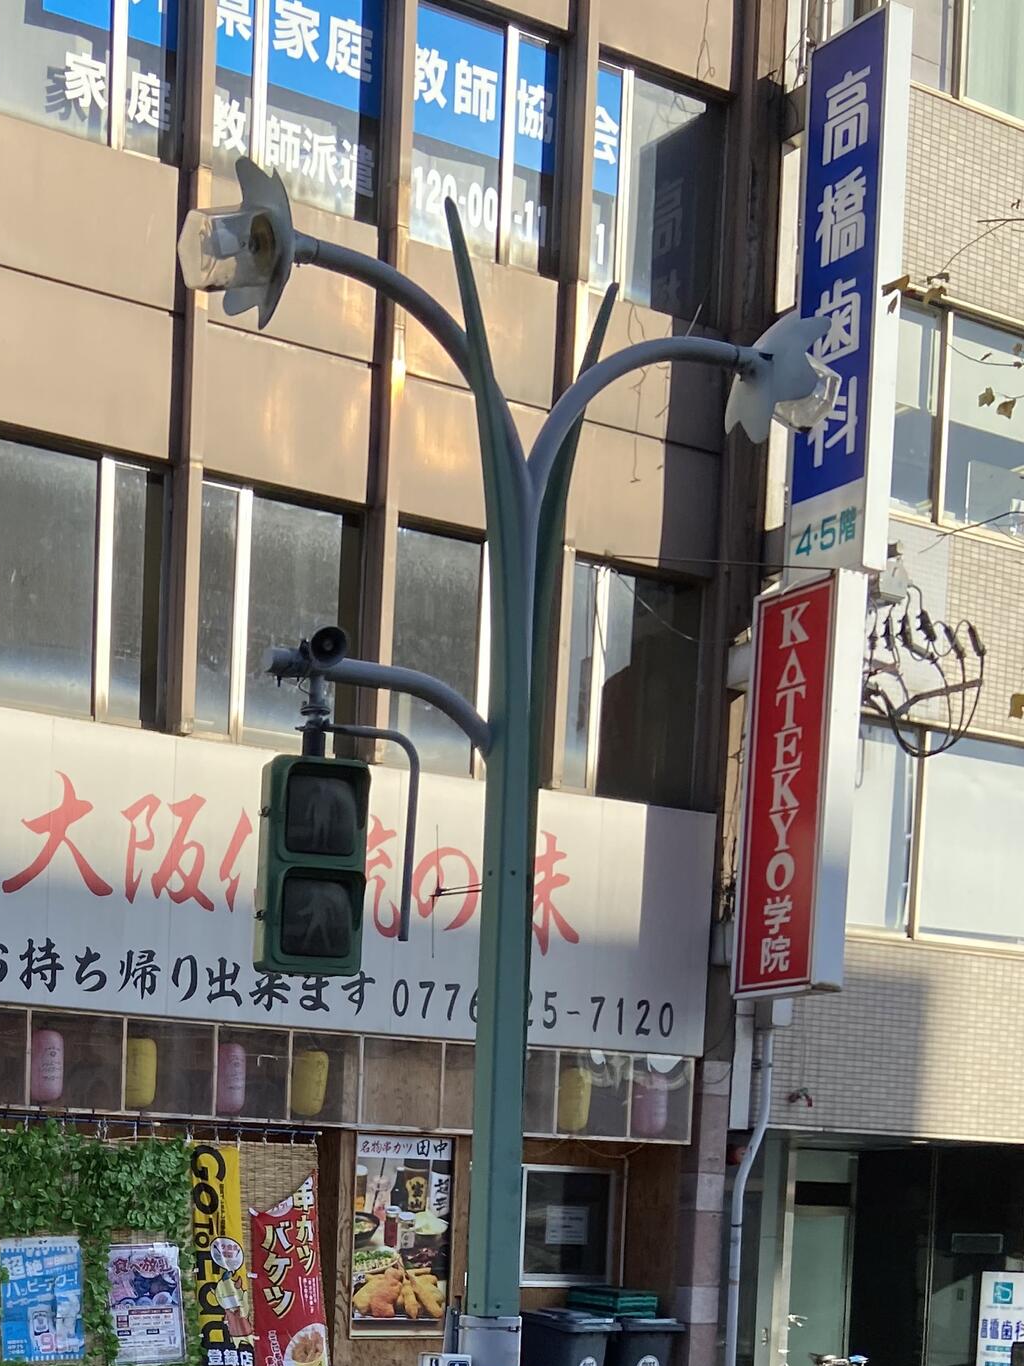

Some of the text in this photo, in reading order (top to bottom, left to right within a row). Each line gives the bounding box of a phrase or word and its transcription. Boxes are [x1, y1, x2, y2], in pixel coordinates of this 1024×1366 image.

[807, 65, 870, 468] 高橋歯科
[416, 1139, 448, 1158] 田中
[261, 1221, 297, 1319] バケツ
[207, 1349, 254, 1366] 登録店
